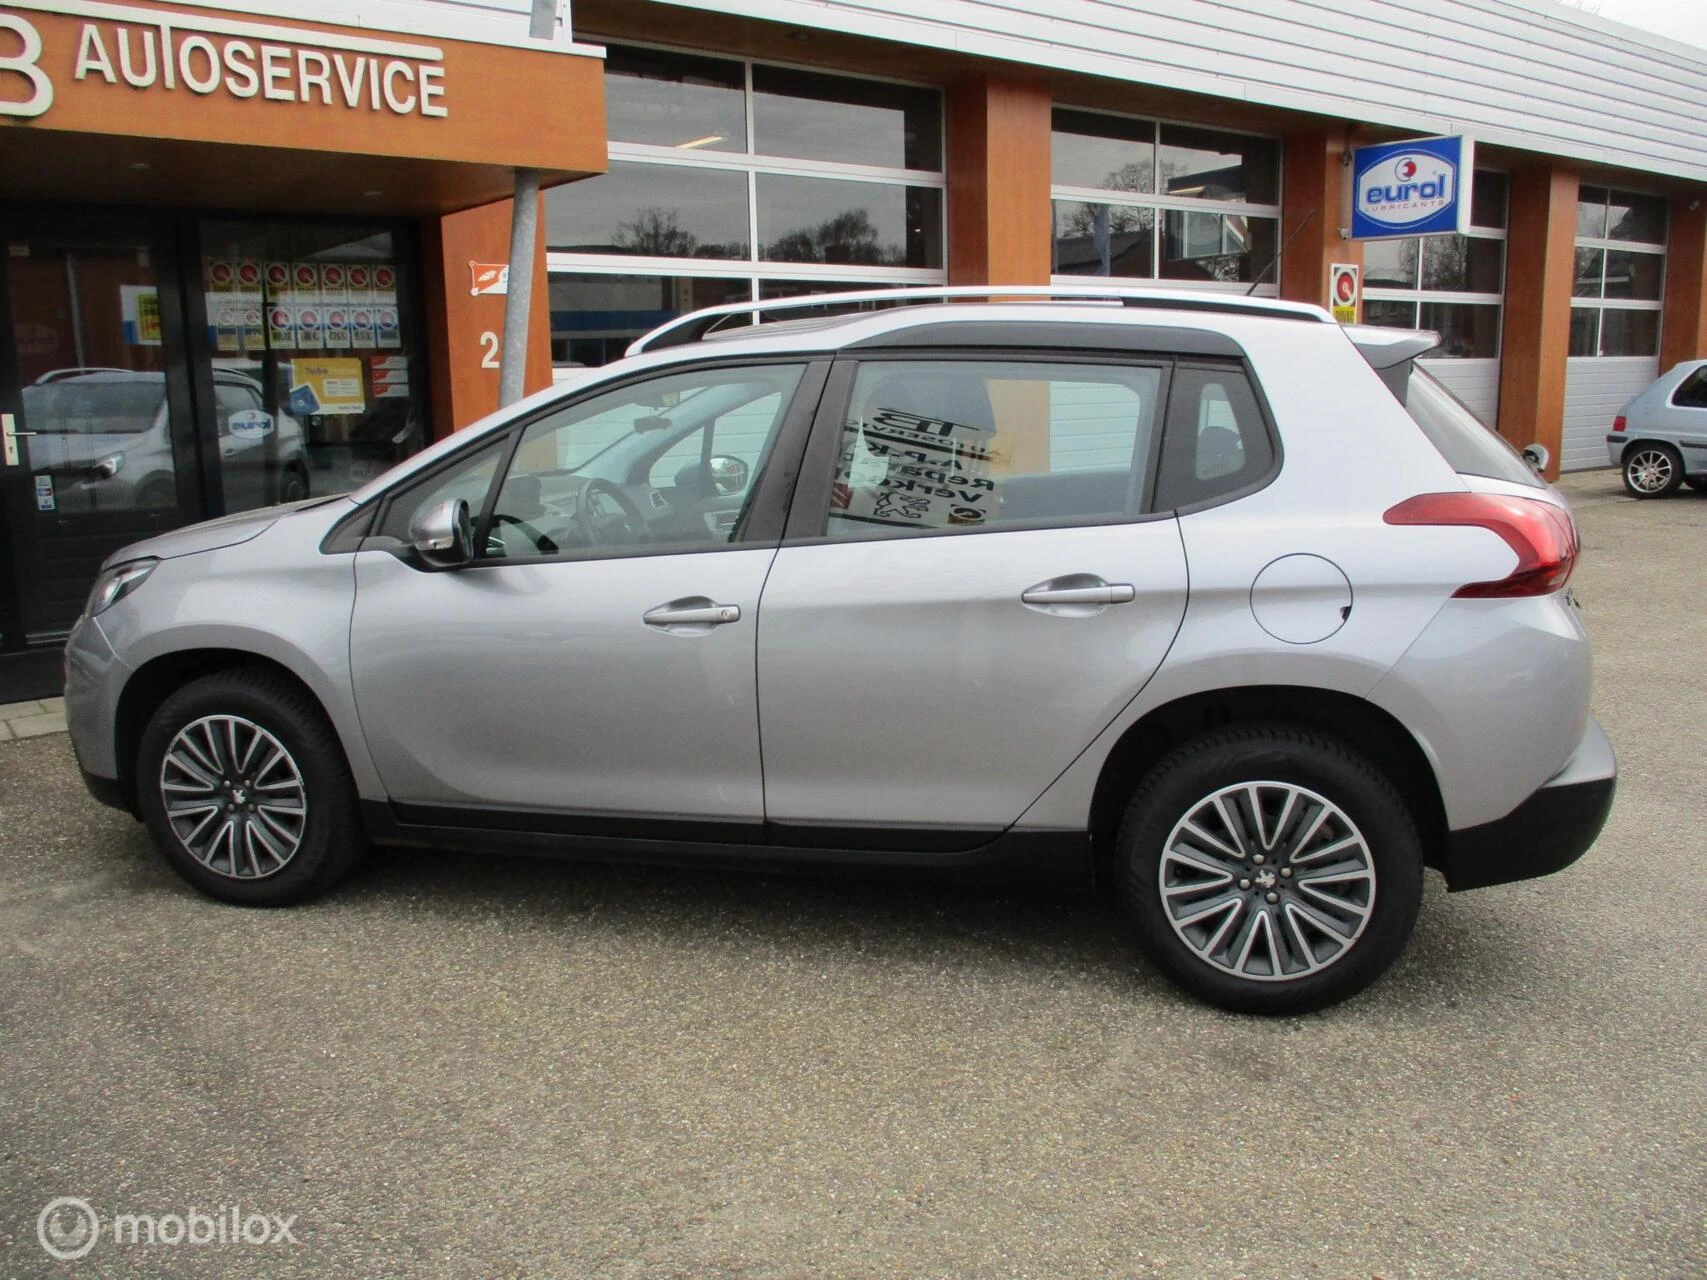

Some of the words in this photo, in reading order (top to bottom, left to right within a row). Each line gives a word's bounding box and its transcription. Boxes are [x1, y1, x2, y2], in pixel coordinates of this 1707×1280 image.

[74, 22, 449, 118] AUTOSERVICE
[1366, 173, 1446, 205] eurol
[1364, 200, 1445, 212] LUBRICANTS
[480, 331, 501, 369] 2
[232, 418, 271, 430] eurol
